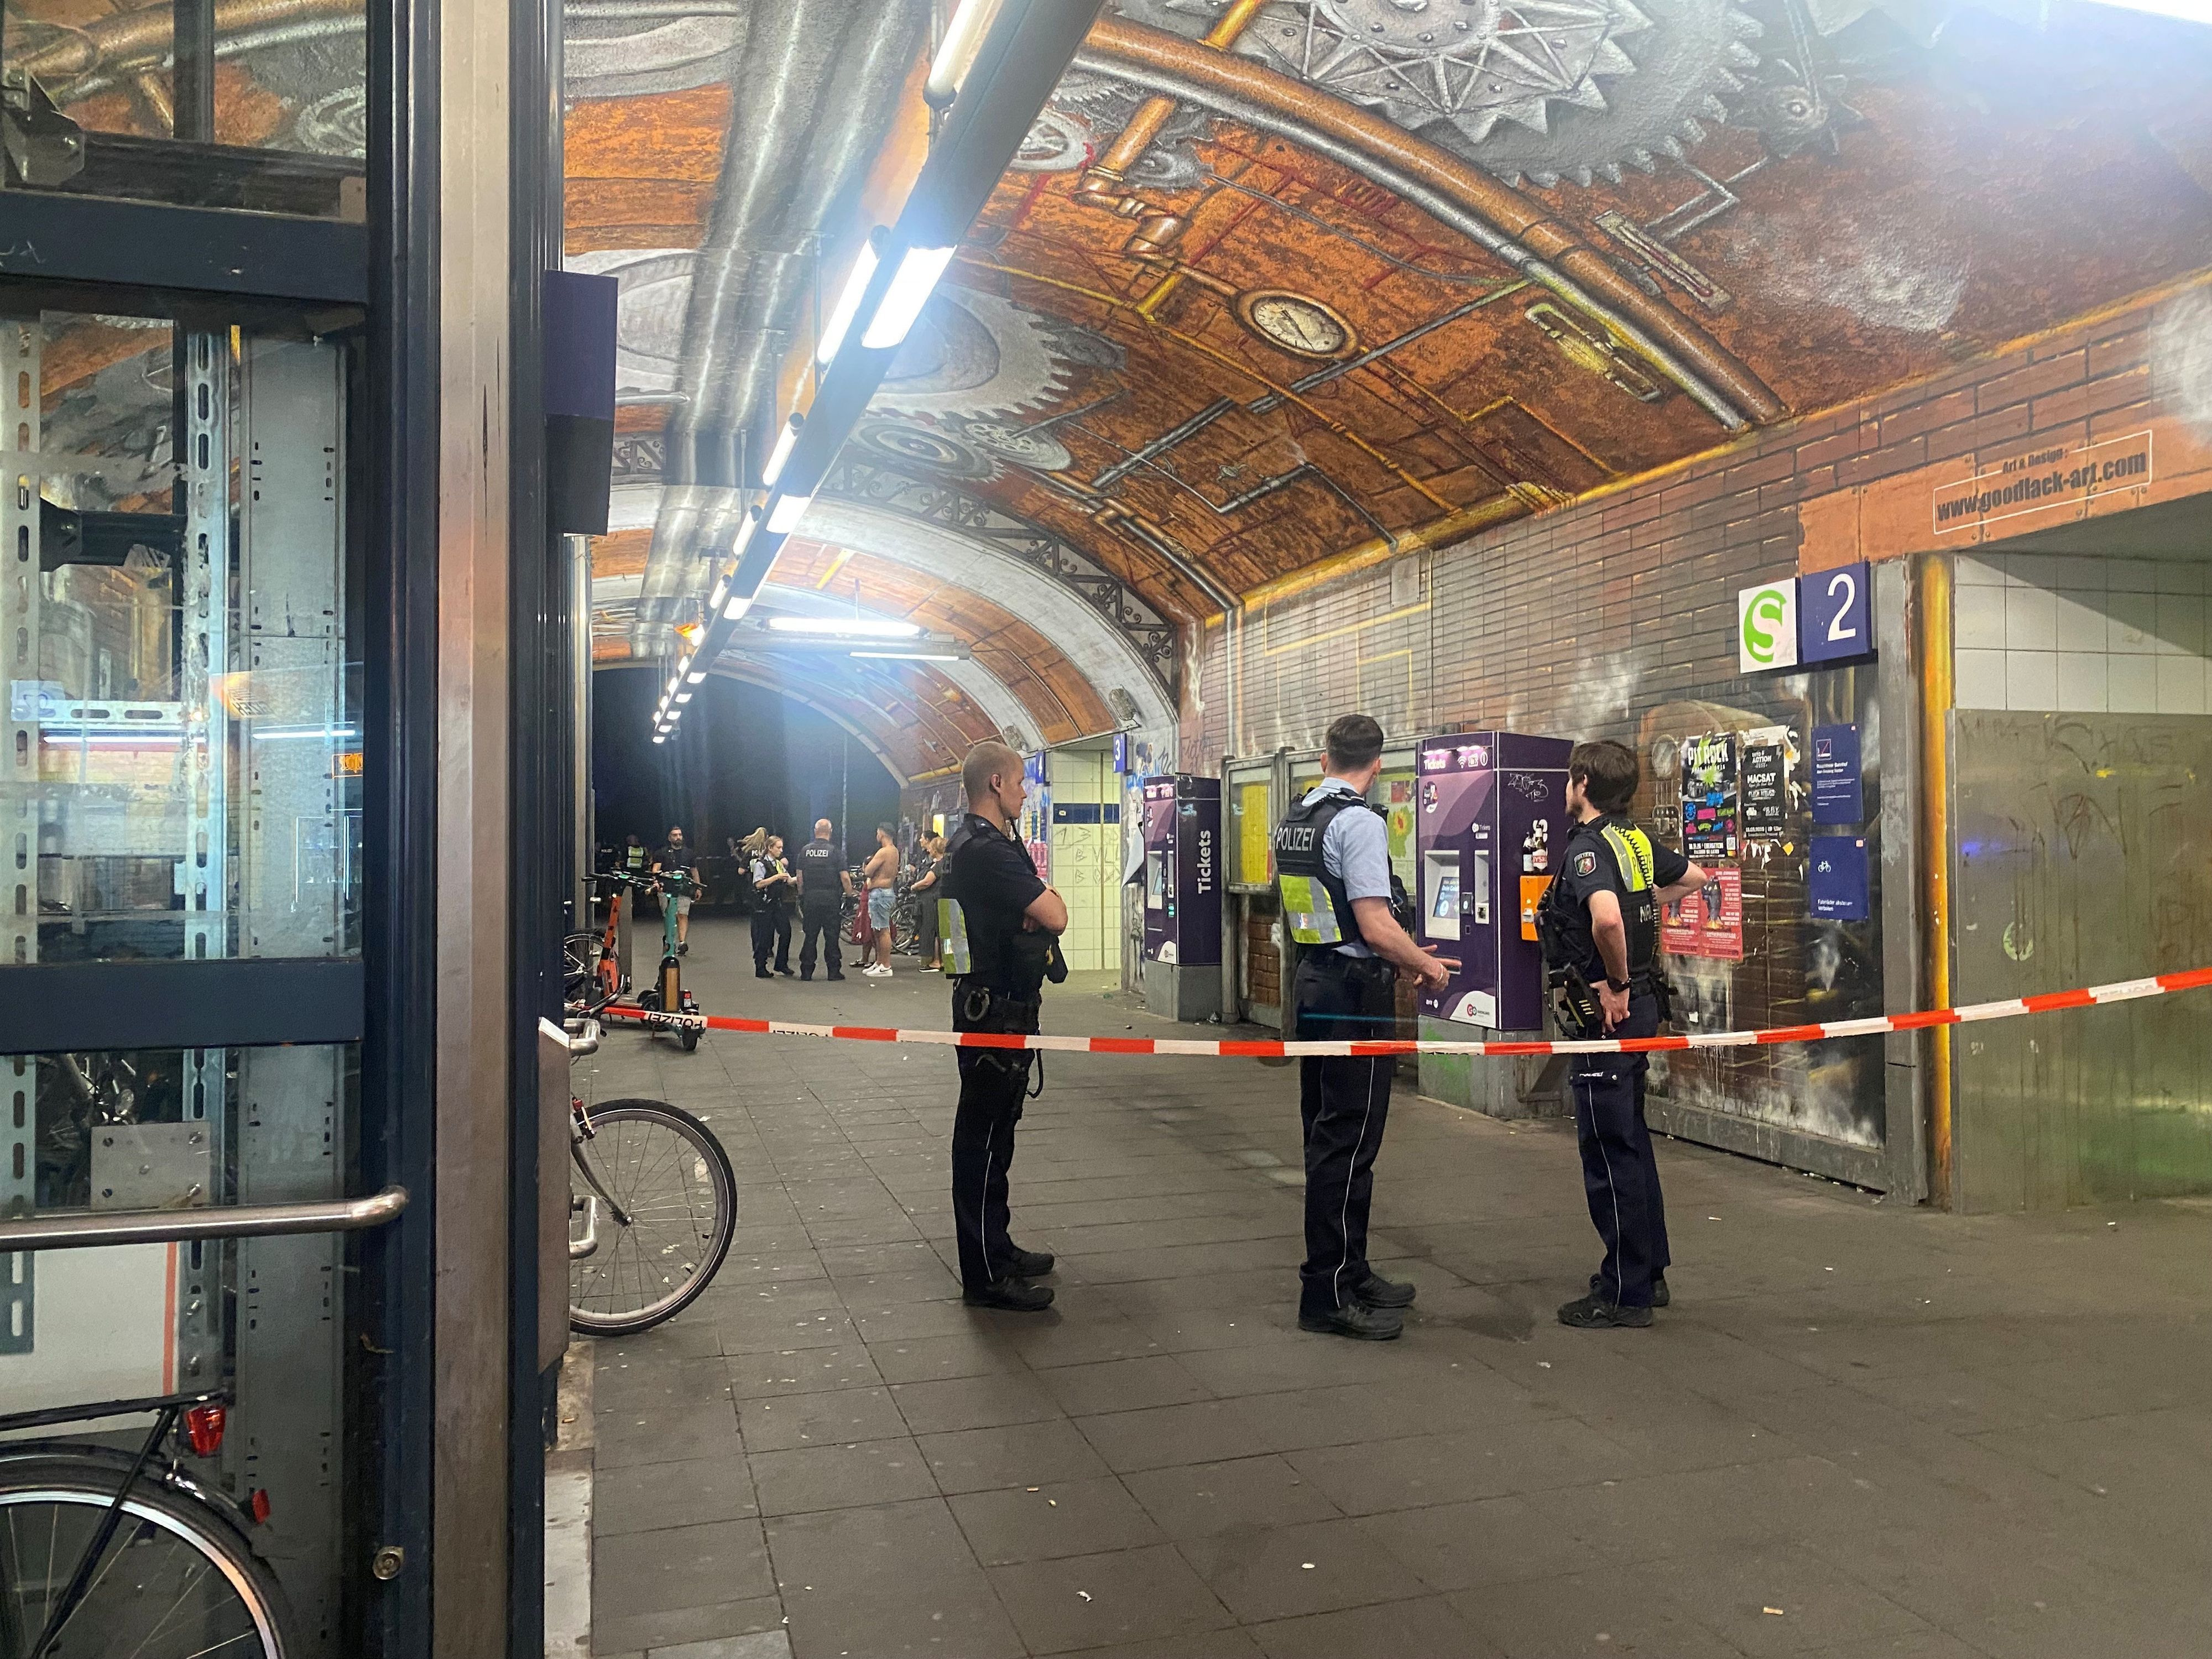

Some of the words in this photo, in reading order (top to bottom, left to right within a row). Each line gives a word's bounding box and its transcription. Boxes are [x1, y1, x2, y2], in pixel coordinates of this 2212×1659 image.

[2002, 461, 2017, 474] Art
[2020, 458, 2026, 469] &
[1937, 452, 2146, 521] www.goodlack-art.com
[1827, 573, 1856, 641] 2
[1744, 589, 1787, 663] S
[1115, 739, 1121, 761] 3
[1752, 755, 1772, 764] ACTION
[1038, 755, 1043, 778] 4
[1747, 773, 1776, 784] MACSAT
[1276, 827, 1316, 851] POLIZEI
[1197, 830, 1211, 894] Tickets
